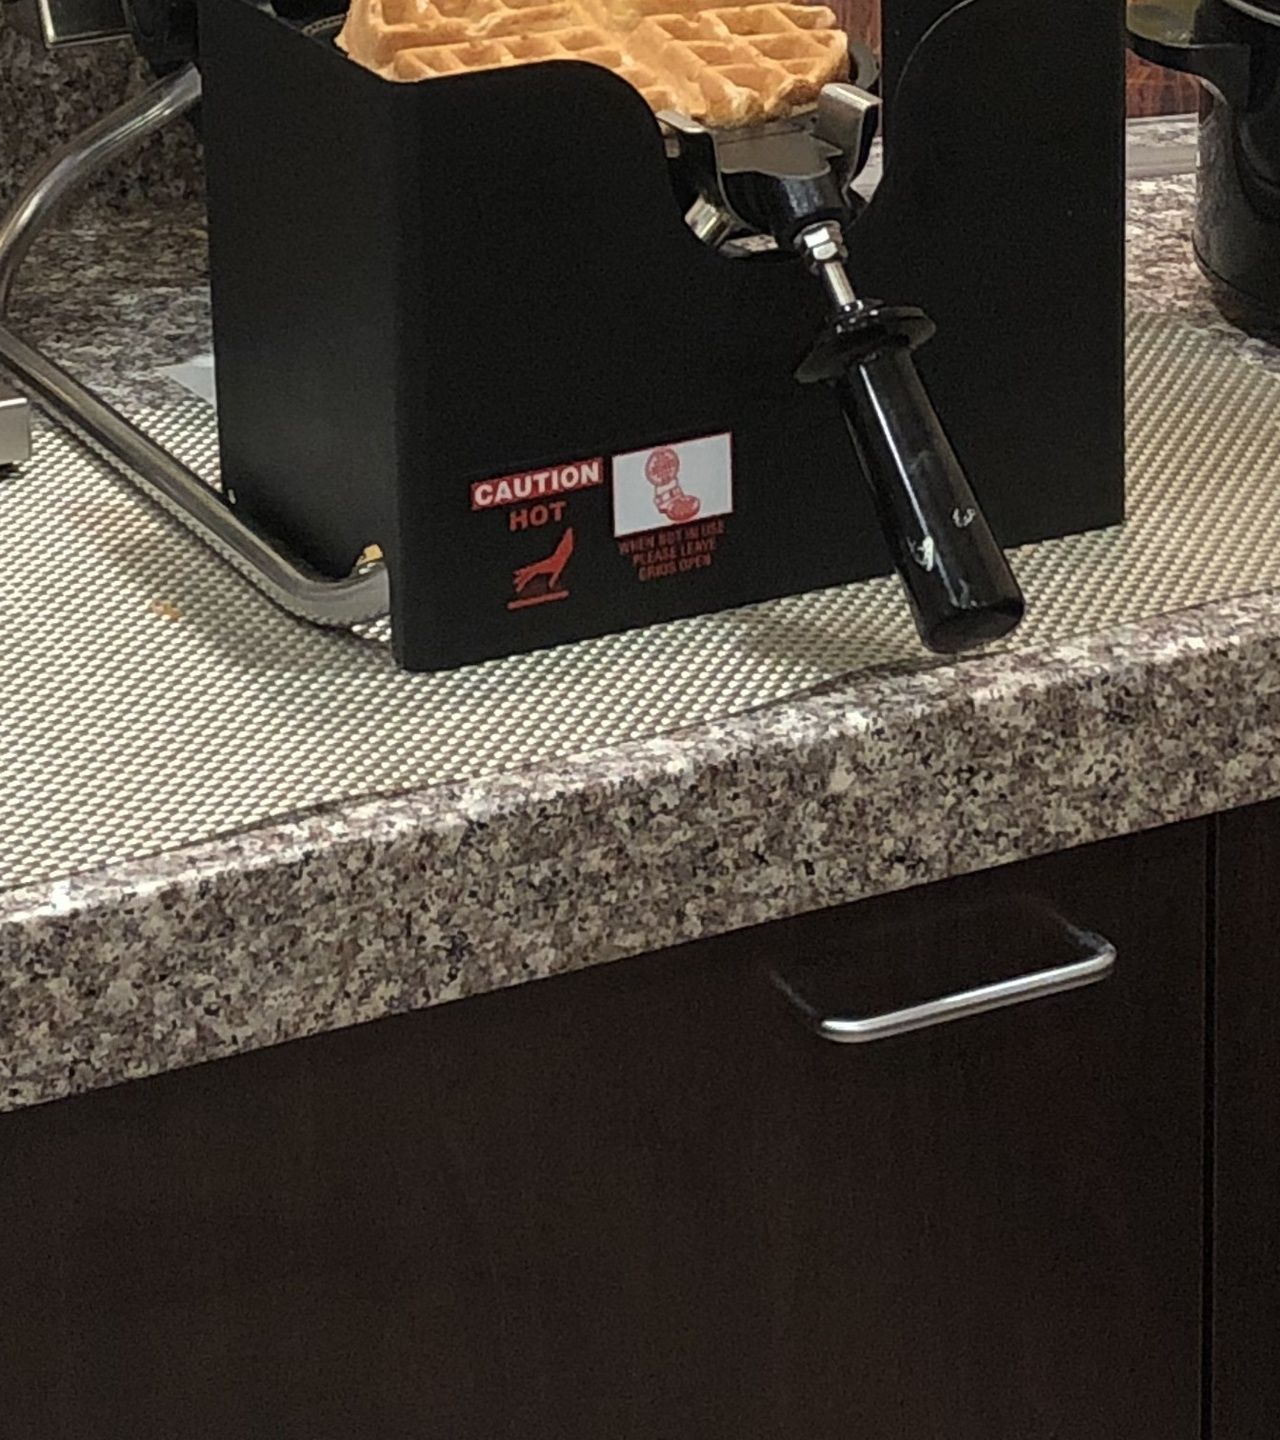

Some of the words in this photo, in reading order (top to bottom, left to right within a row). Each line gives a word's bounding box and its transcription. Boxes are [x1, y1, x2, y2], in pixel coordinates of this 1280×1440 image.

[473, 461, 600, 506] CAUTION
[509, 501, 567, 532] HOT
[618, 535, 655, 555] WHEN
[632, 545, 678, 567] PLEASE
[679, 552, 712, 573] OPEN
